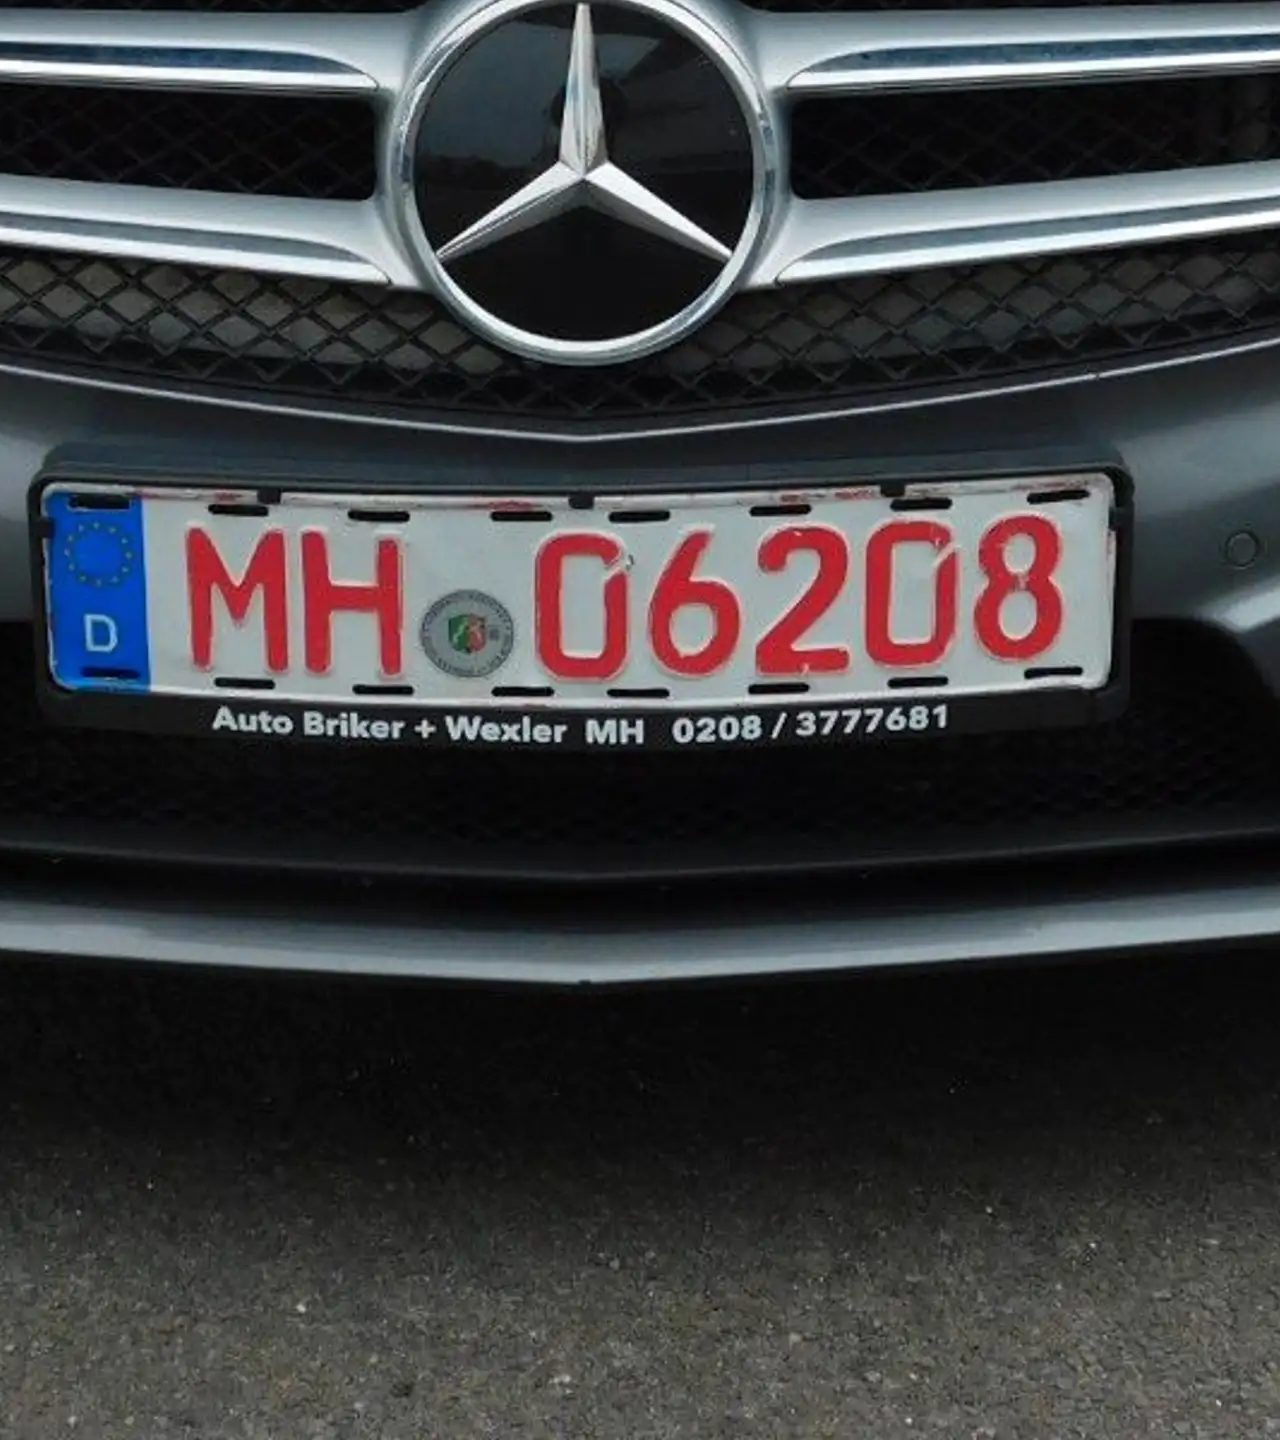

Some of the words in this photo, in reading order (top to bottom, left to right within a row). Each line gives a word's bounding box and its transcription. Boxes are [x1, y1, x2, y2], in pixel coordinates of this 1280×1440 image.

[185, 524, 403, 677] MH
[534, 512, 1063, 680] 06208
[83, 613, 118, 653] D
[212, 706, 294, 734] Auto
[303, 711, 406, 739] Briker
[414, 717, 437, 739] +
[444, 715, 568, 744] Wexler
[584, 718, 645, 745] MH
[672, 715, 763, 744] 0208
[795, 704, 949, 738] 3777681
